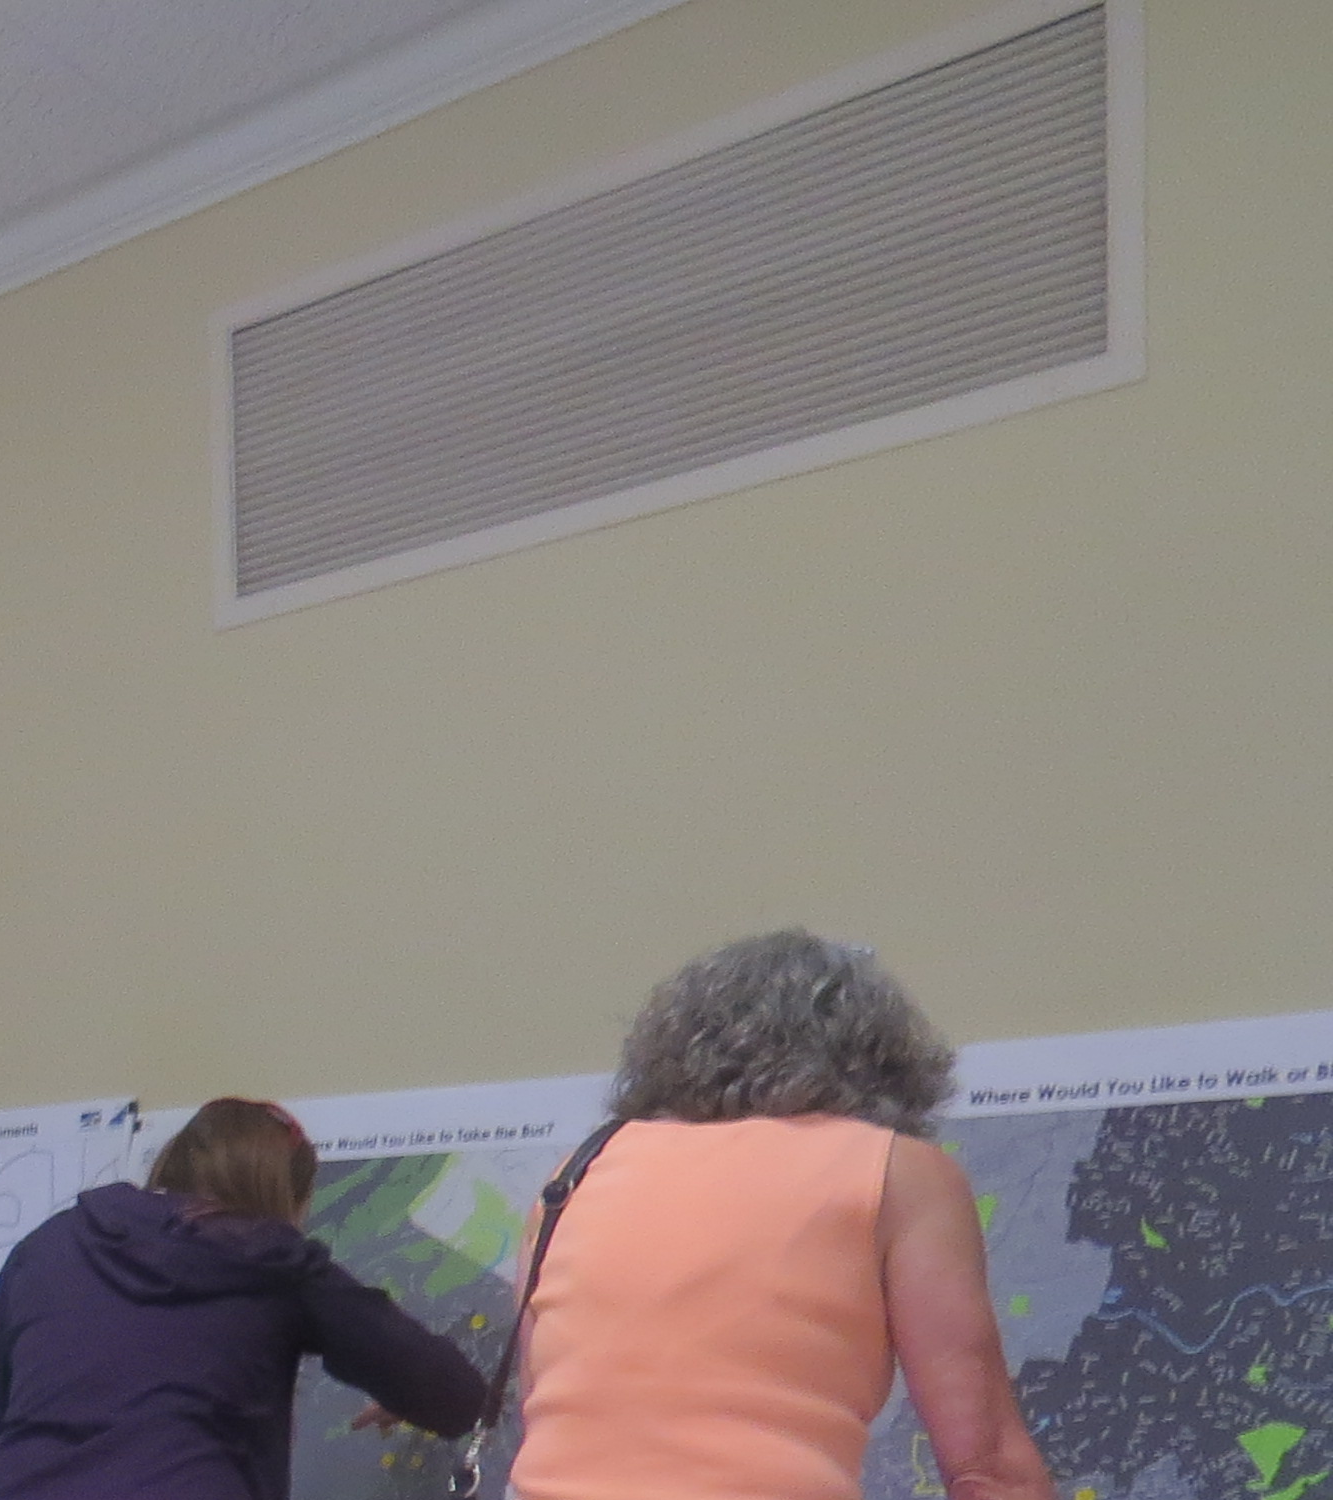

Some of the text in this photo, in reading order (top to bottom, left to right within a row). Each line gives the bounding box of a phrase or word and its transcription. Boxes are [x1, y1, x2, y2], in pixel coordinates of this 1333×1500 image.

[969, 1087, 1030, 1105] Where
[1038, 1082, 1101, 1101] Would
[1107, 1078, 1144, 1097] You
[1150, 1073, 1191, 1093] Like
[1197, 1067, 1218, 1090] to
[1227, 1064, 1278, 1087] Walk
[1287, 1063, 1309, 1083] or
[337, 1134, 379, 1151] Would
[409, 1128, 436, 1146] Like
[440, 1128, 454, 1142] to
